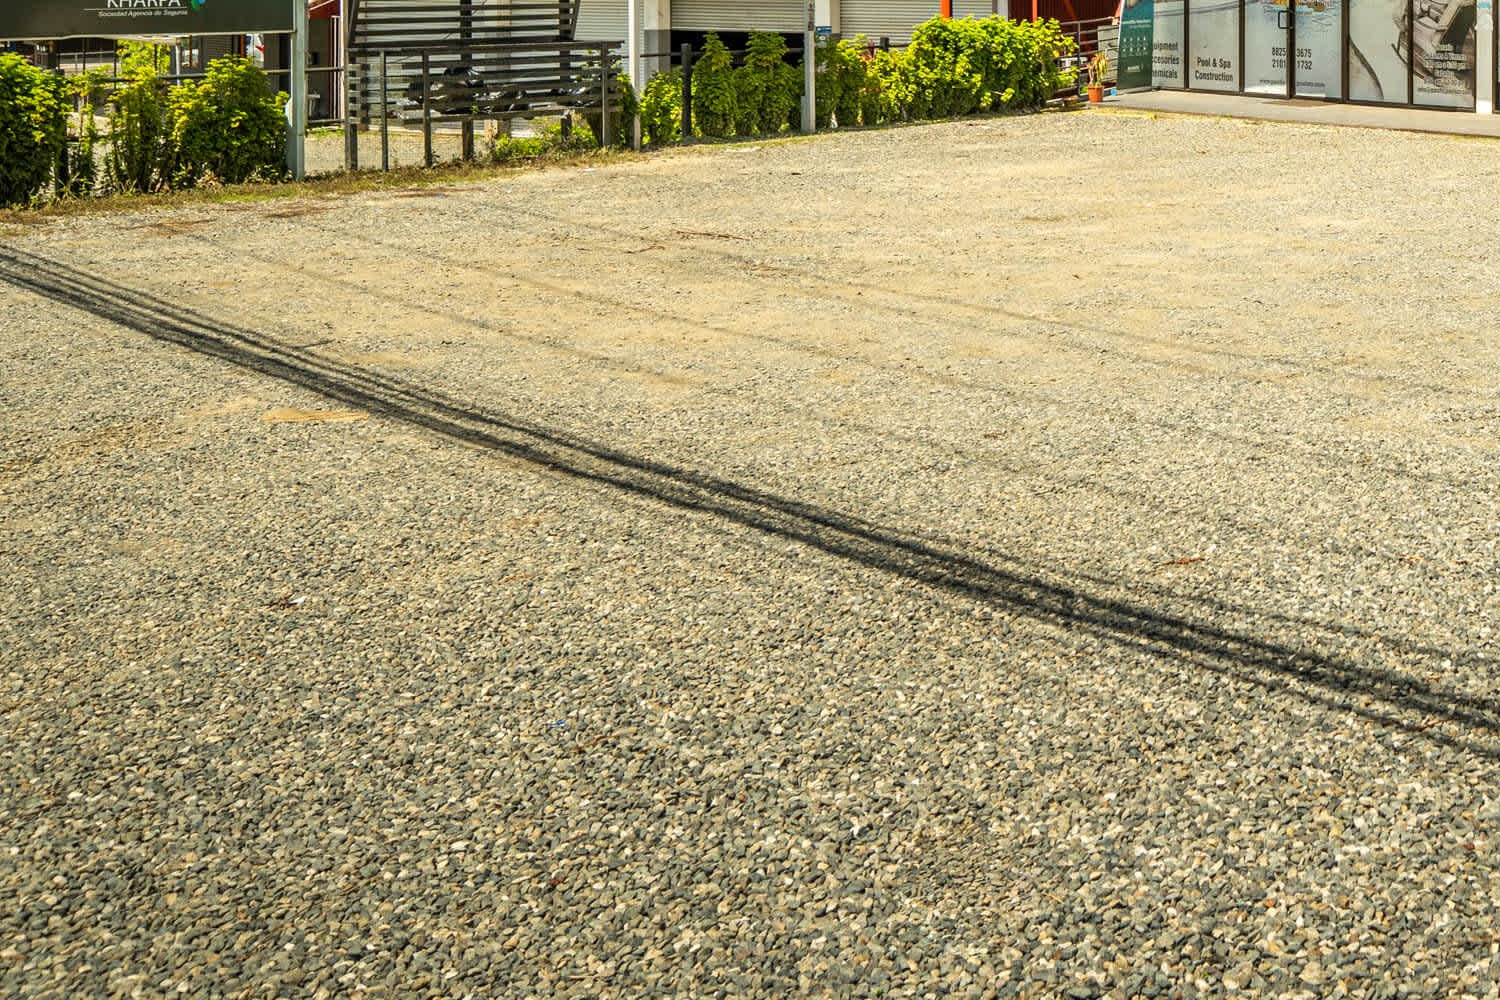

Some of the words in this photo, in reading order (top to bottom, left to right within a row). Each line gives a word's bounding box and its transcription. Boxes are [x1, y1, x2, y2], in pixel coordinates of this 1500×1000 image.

[1272, 47, 1286, 56] 8825
[1297, 49, 1312, 58] 3675
[1197, 57, 1211, 67] Pool
[1218, 58, 1231, 69] Spa
[1297, 61, 1312, 70] 1732
[1195, 70, 1234, 81] Construction
